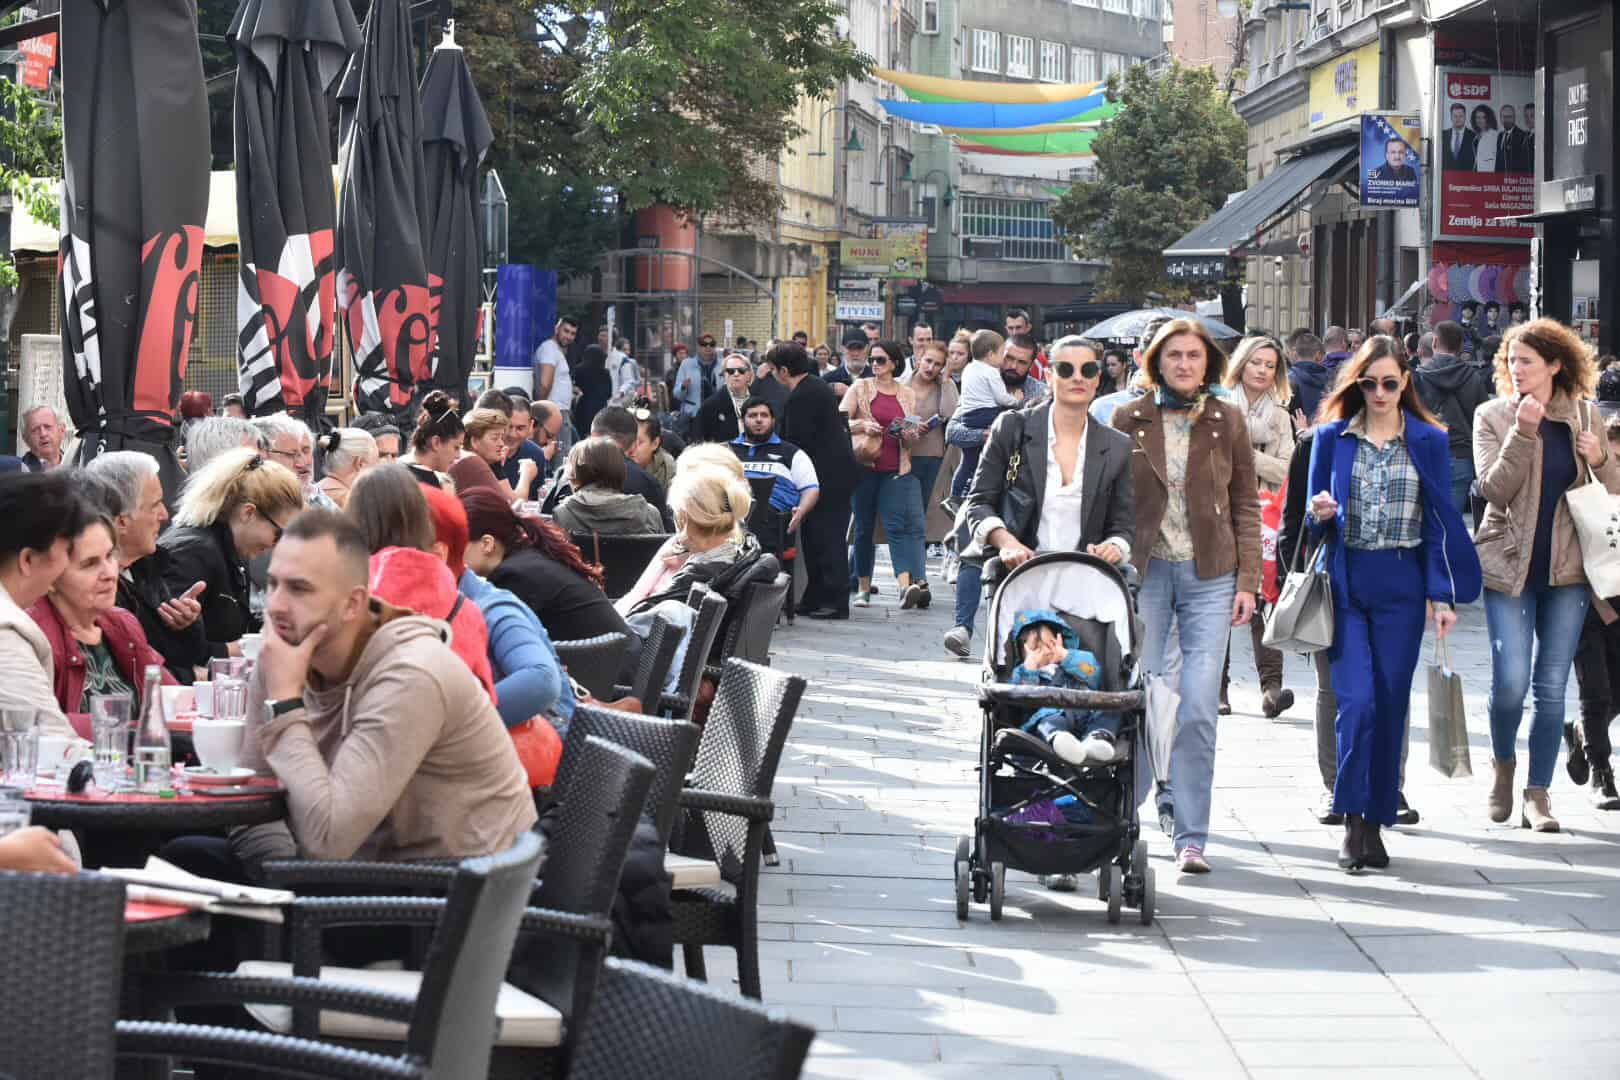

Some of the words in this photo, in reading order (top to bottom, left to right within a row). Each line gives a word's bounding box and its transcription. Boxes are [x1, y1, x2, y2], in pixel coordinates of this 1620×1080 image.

[1463, 85, 1488, 96] SDP
[1568, 117, 1588, 146] FINEST
[1448, 215, 1482, 228] Zemlja
[1485, 218, 1497, 227] za
